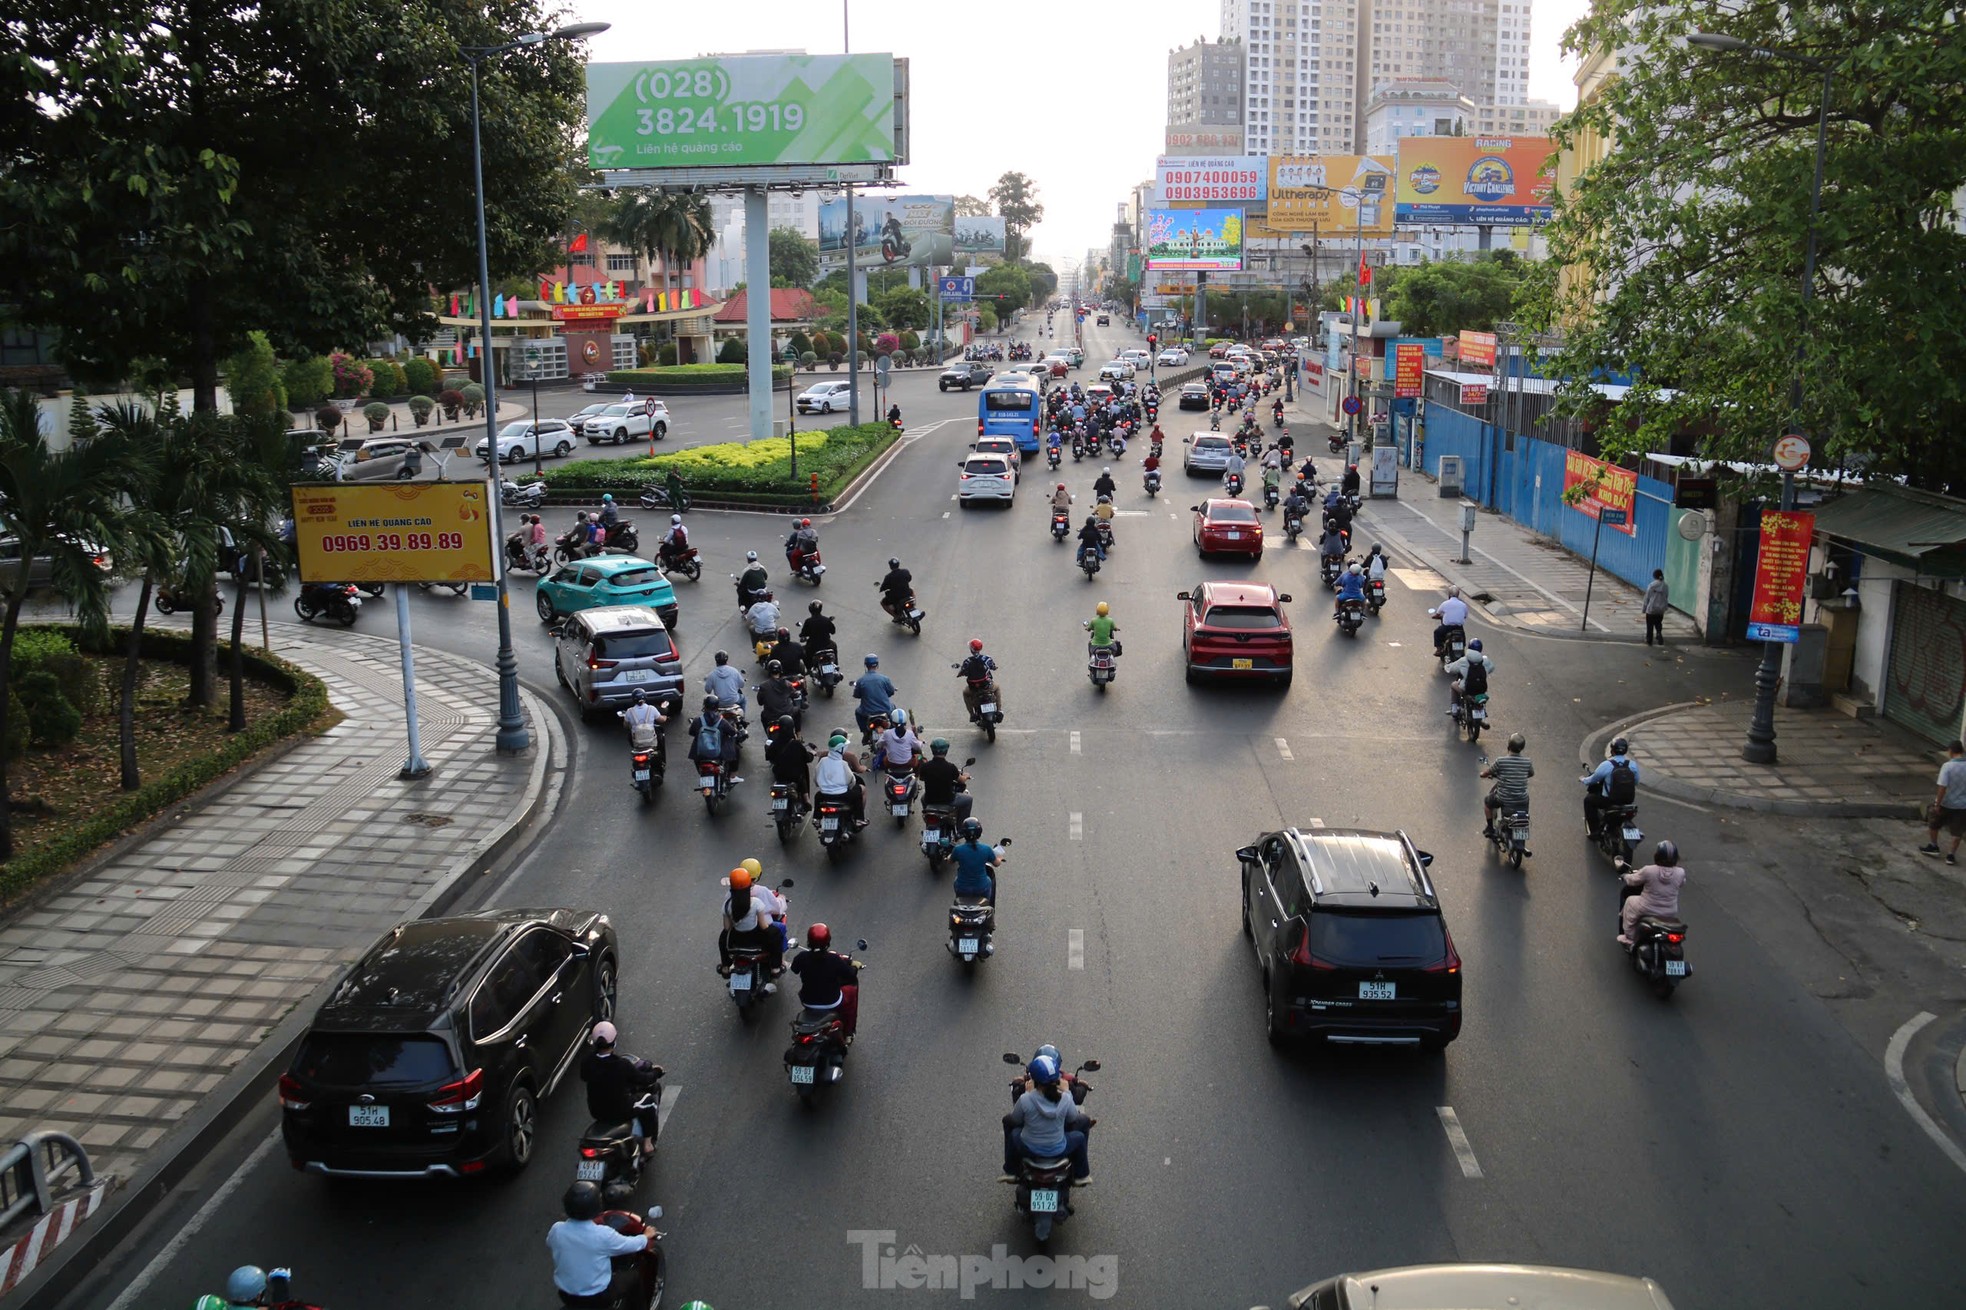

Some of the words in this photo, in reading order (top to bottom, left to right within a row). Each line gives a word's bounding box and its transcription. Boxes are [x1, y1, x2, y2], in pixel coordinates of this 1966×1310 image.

[635, 70, 728, 104] (028)
[636, 103, 803, 136] 3824.1919
[636, 143, 662, 154] Liên
[664, 143, 678, 155] hệ
[681, 142, 718, 154] quảng
[720, 141, 742, 152] cáo
[1166, 171, 1257, 184] 0907400059
[1166, 186, 1256, 199] 0903953696
[1272, 188, 1330, 201] Ultherapy
[322, 532, 463, 553] 0969.39.89.89
[1369, 982, 1386, 990] 51H
[1362, 990, 1392, 999] 935.52
[360, 1106, 378, 1116] 51H
[353, 1116, 385, 1126] 905.48
